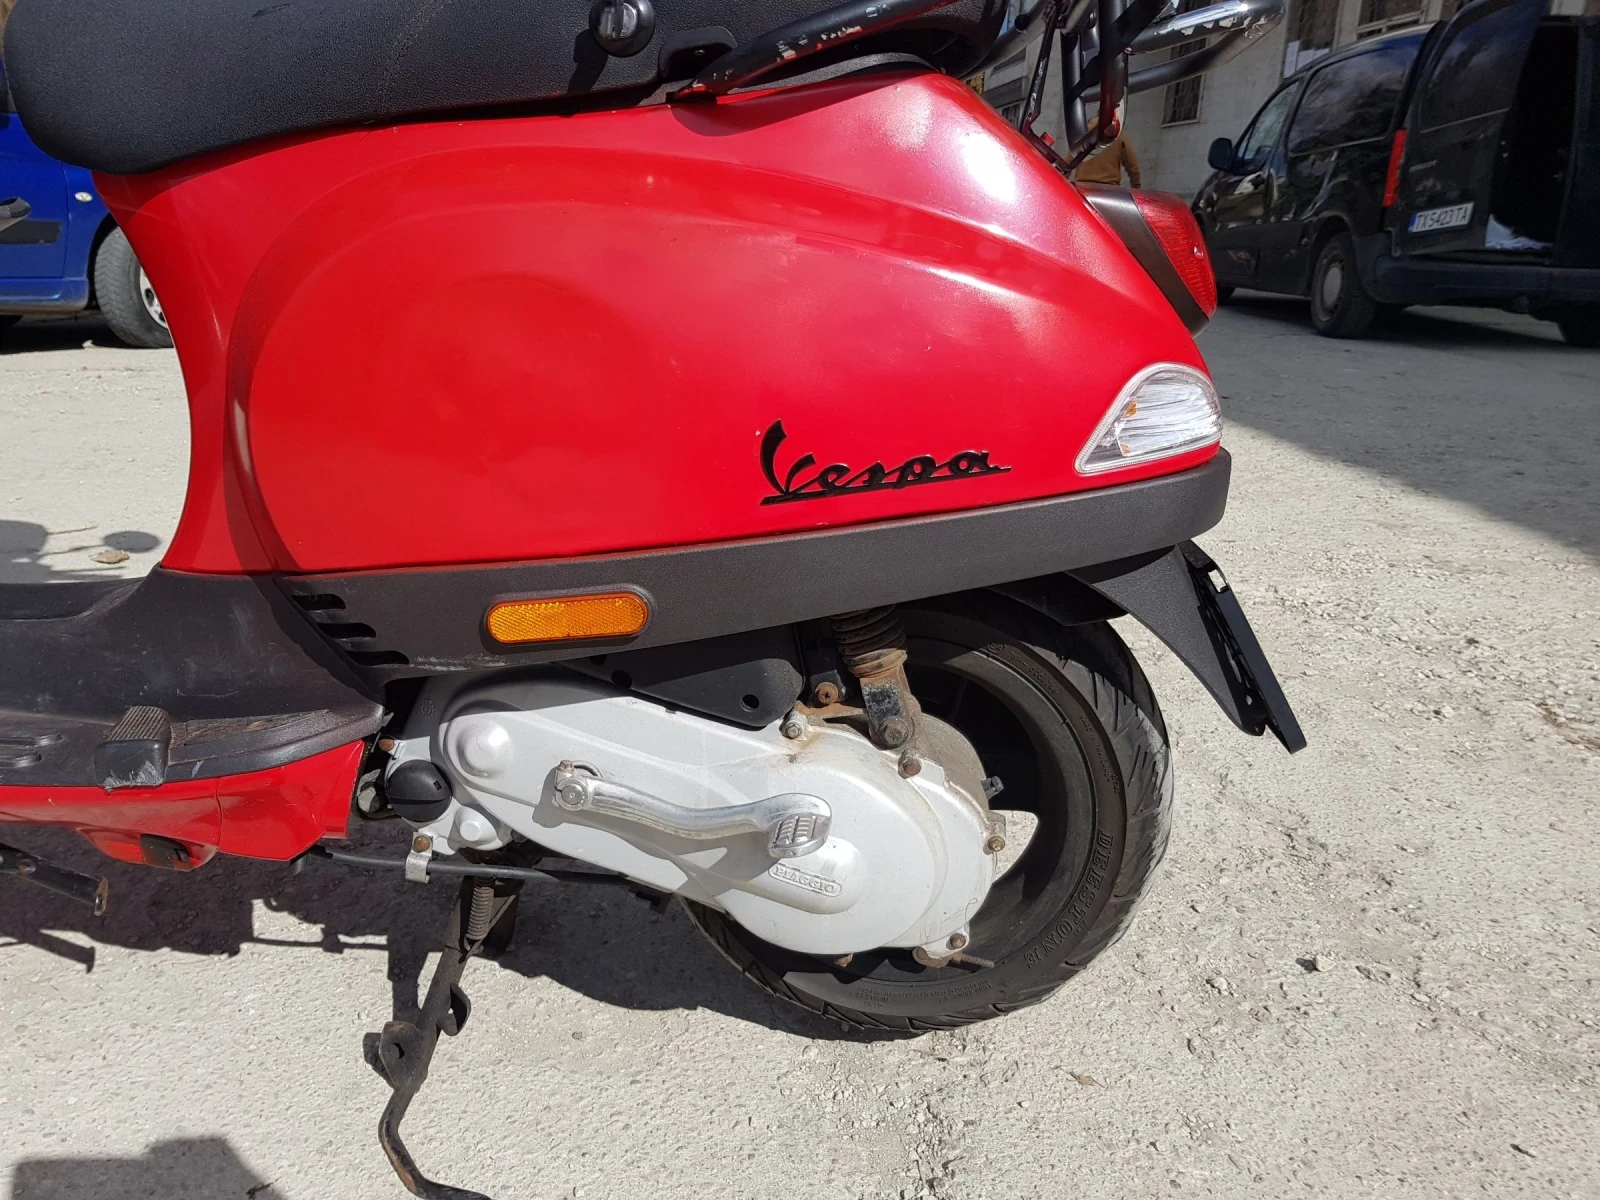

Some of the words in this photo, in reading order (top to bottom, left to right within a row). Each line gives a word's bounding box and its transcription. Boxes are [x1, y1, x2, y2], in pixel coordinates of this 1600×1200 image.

[759, 418, 1012, 507] Vespa
[773, 865, 836, 893] PIAGGIO
[1023, 829, 1114, 969] DEESTONE
